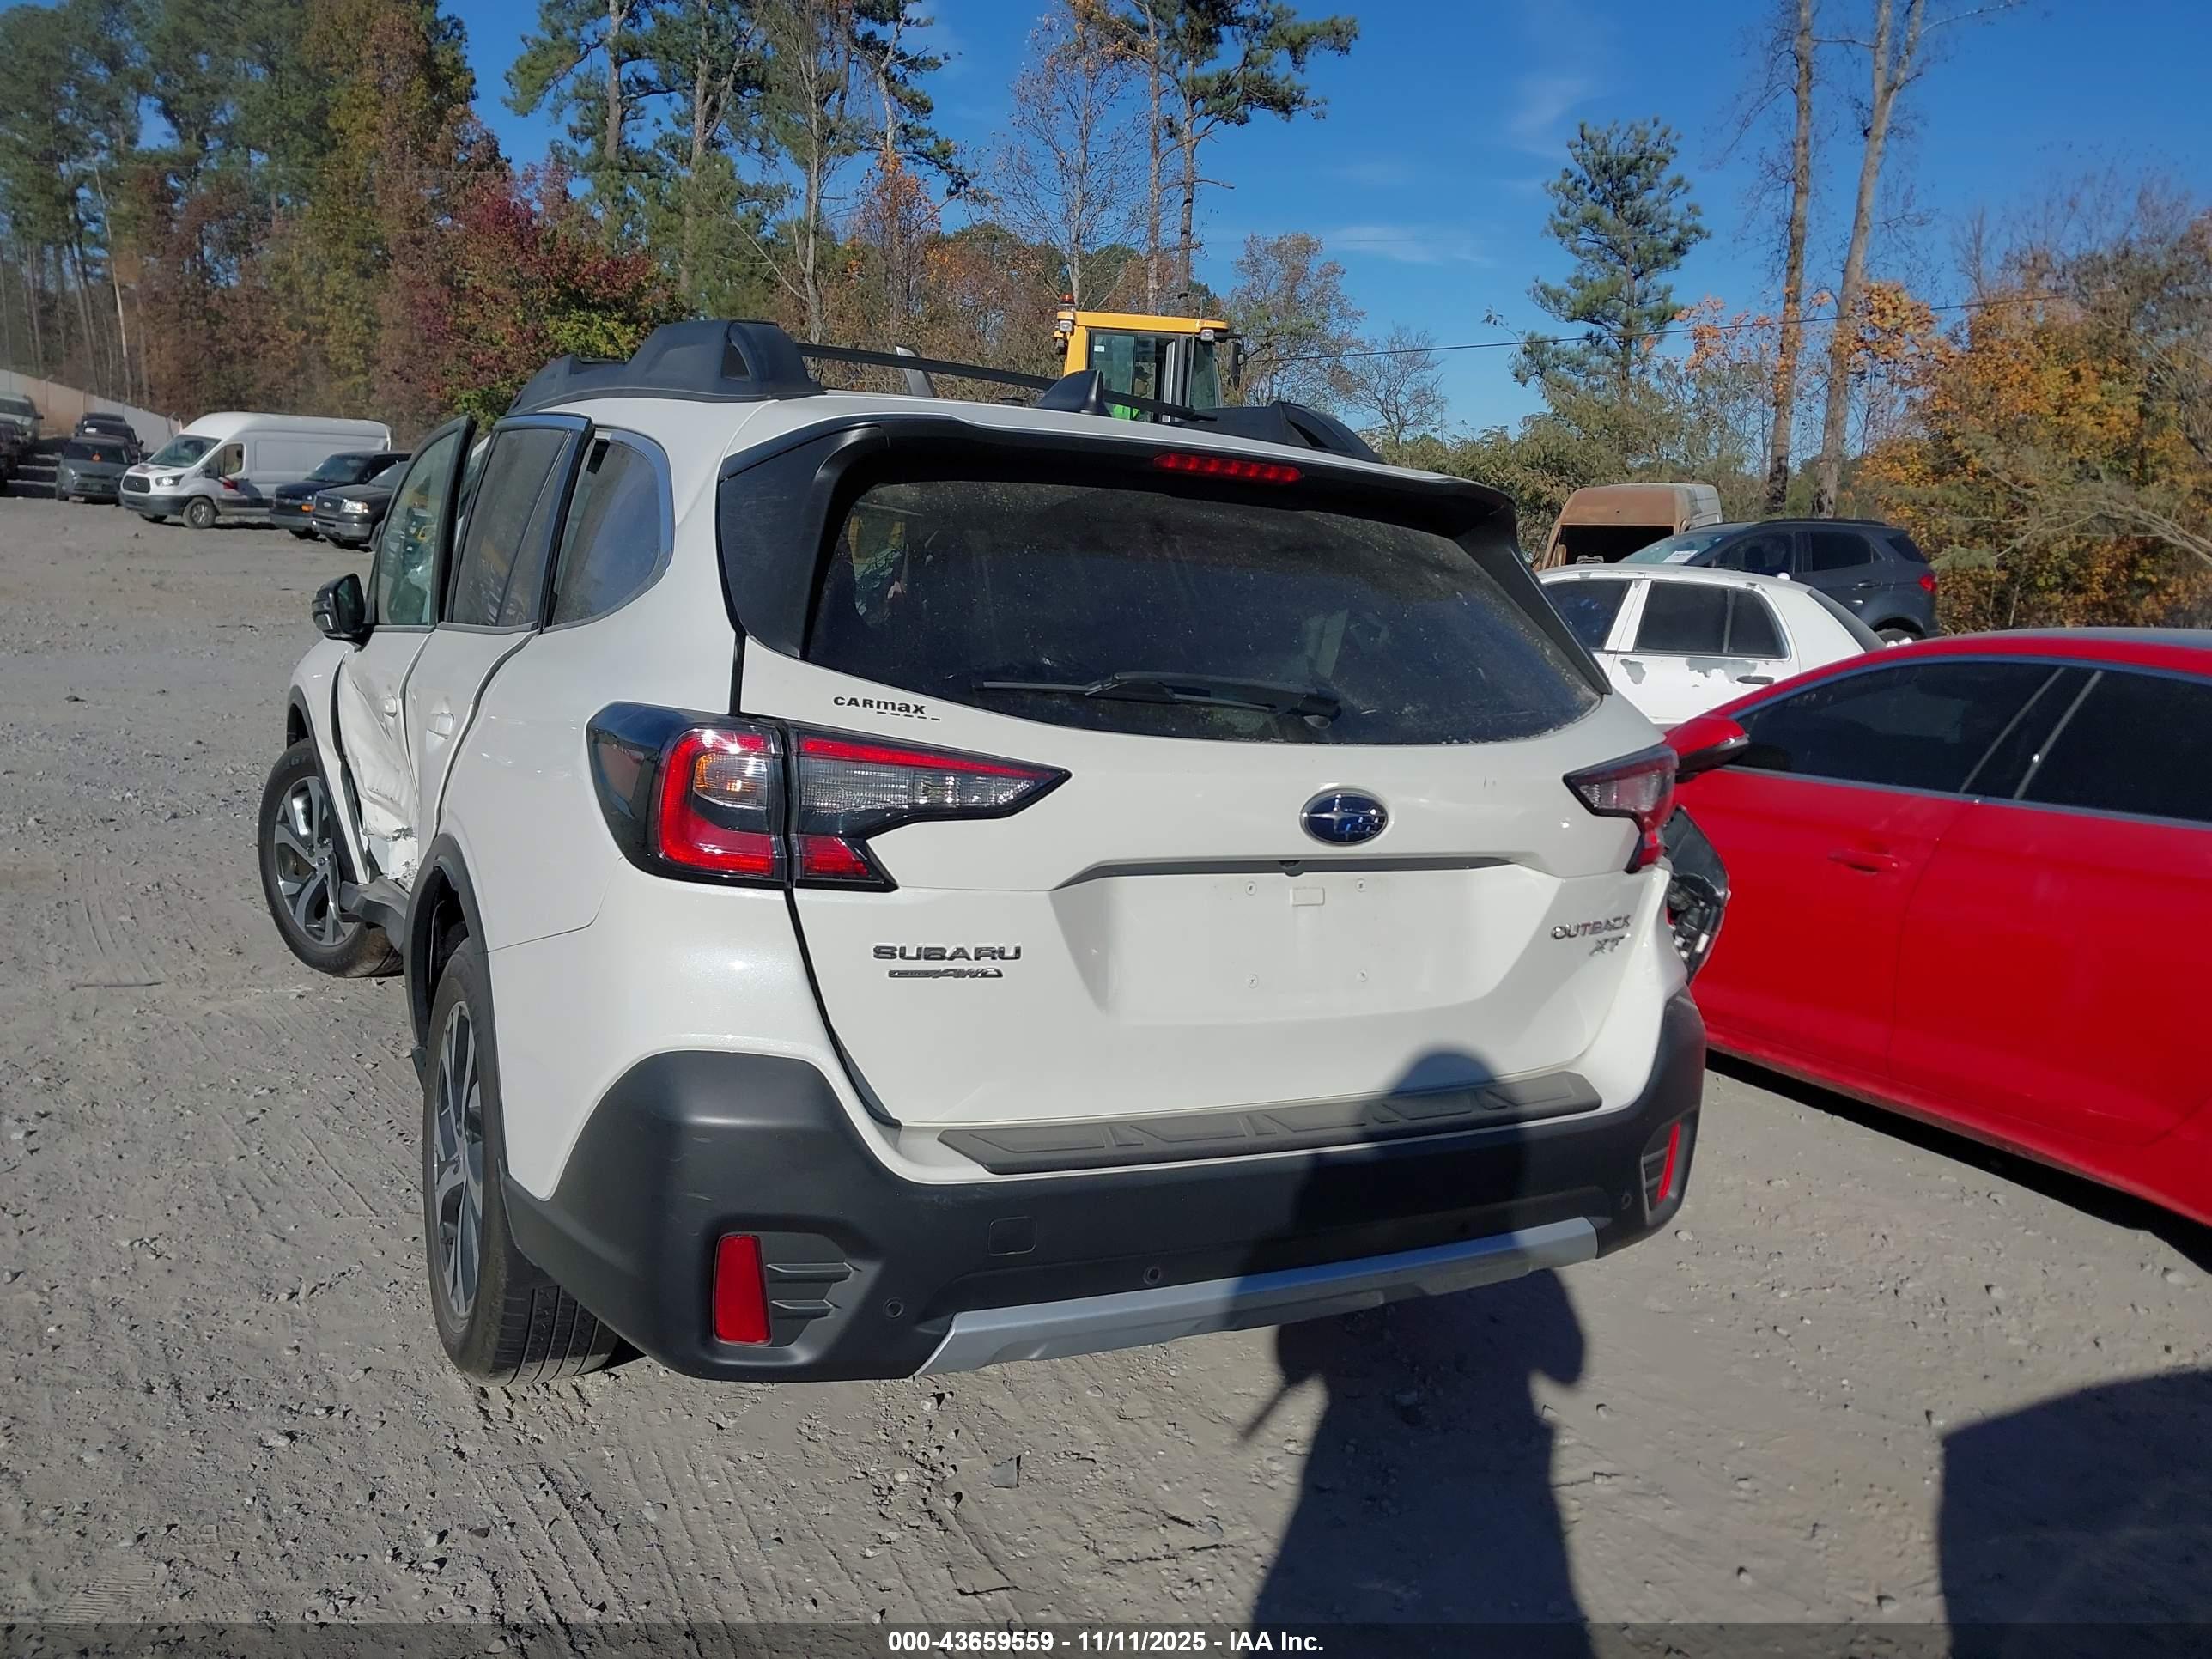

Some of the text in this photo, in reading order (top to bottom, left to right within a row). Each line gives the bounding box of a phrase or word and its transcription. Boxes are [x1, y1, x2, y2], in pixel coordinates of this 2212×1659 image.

[1551, 915, 1632, 940] OUTBACK
[873, 945, 1022, 961] SUBARU
[1589, 936, 1626, 957] XT
